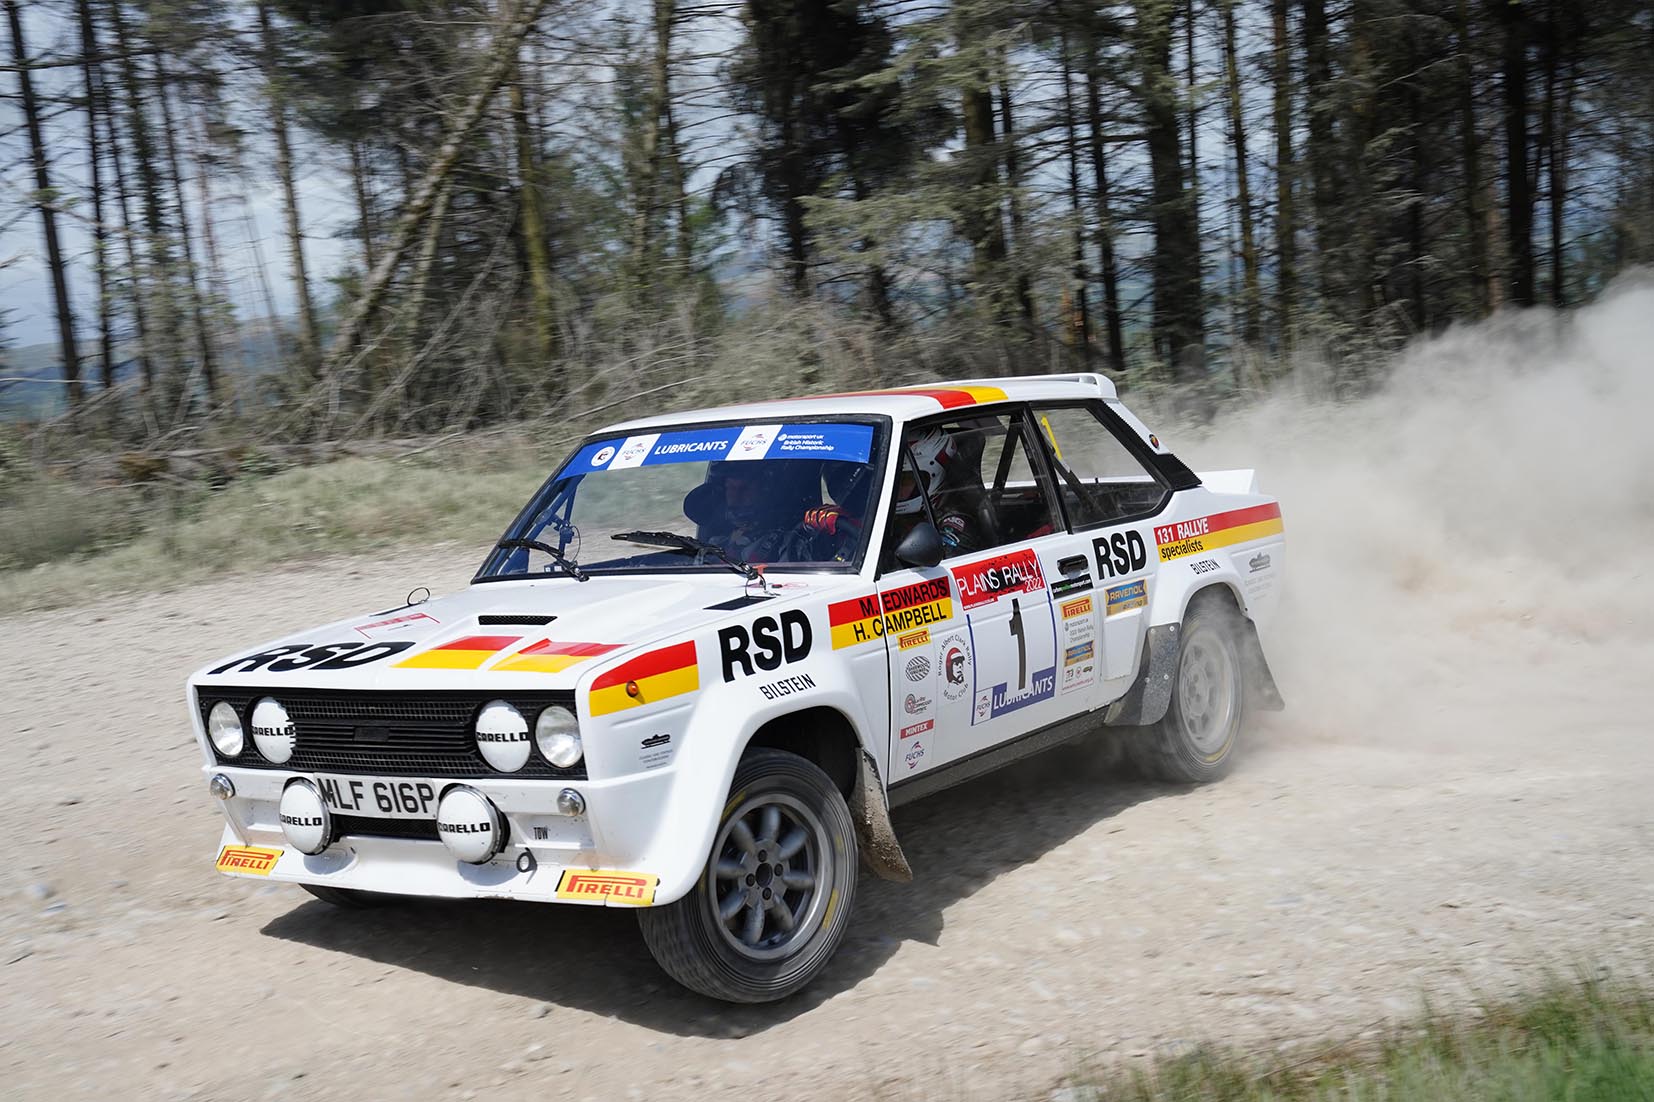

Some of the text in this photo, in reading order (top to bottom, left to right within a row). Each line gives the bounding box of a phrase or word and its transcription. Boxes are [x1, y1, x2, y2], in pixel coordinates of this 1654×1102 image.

[654, 441, 729, 455] LUBRICANTS
[1157, 518, 1209, 544] 131 RALLYE
[1092, 530, 1146, 580] RSD
[1161, 540, 1204, 560] specialists
[1190, 558, 1221, 575] BILSTEIN
[956, 568, 1000, 598] PLAINS
[1001, 560, 1039, 586] RALLY
[1025, 577, 1042, 592] 2022
[859, 598, 879, 617] M.
[881, 580, 948, 611] EDWARDS
[1110, 584, 1143, 601] RAVENOL
[1062, 599, 1090, 617] PIRELLI
[853, 623, 870, 641] H.
[872, 603, 947, 636] CAMPBELL
[717, 609, 813, 683] RSD
[899, 630, 928, 648] PIRELLI
[1009, 598, 1026, 690] 1
[206, 641, 416, 675] RSD
[759, 673, 816, 700] BILSTEIN
[905, 722, 928, 736] MINTEX
[905, 749, 925, 762] FUCHS
[317, 778, 435, 814] MLF 616P
[533, 826, 549, 840] TOW
[220, 850, 275, 870] PIRELLI
[566, 875, 647, 899] PIRELLI
